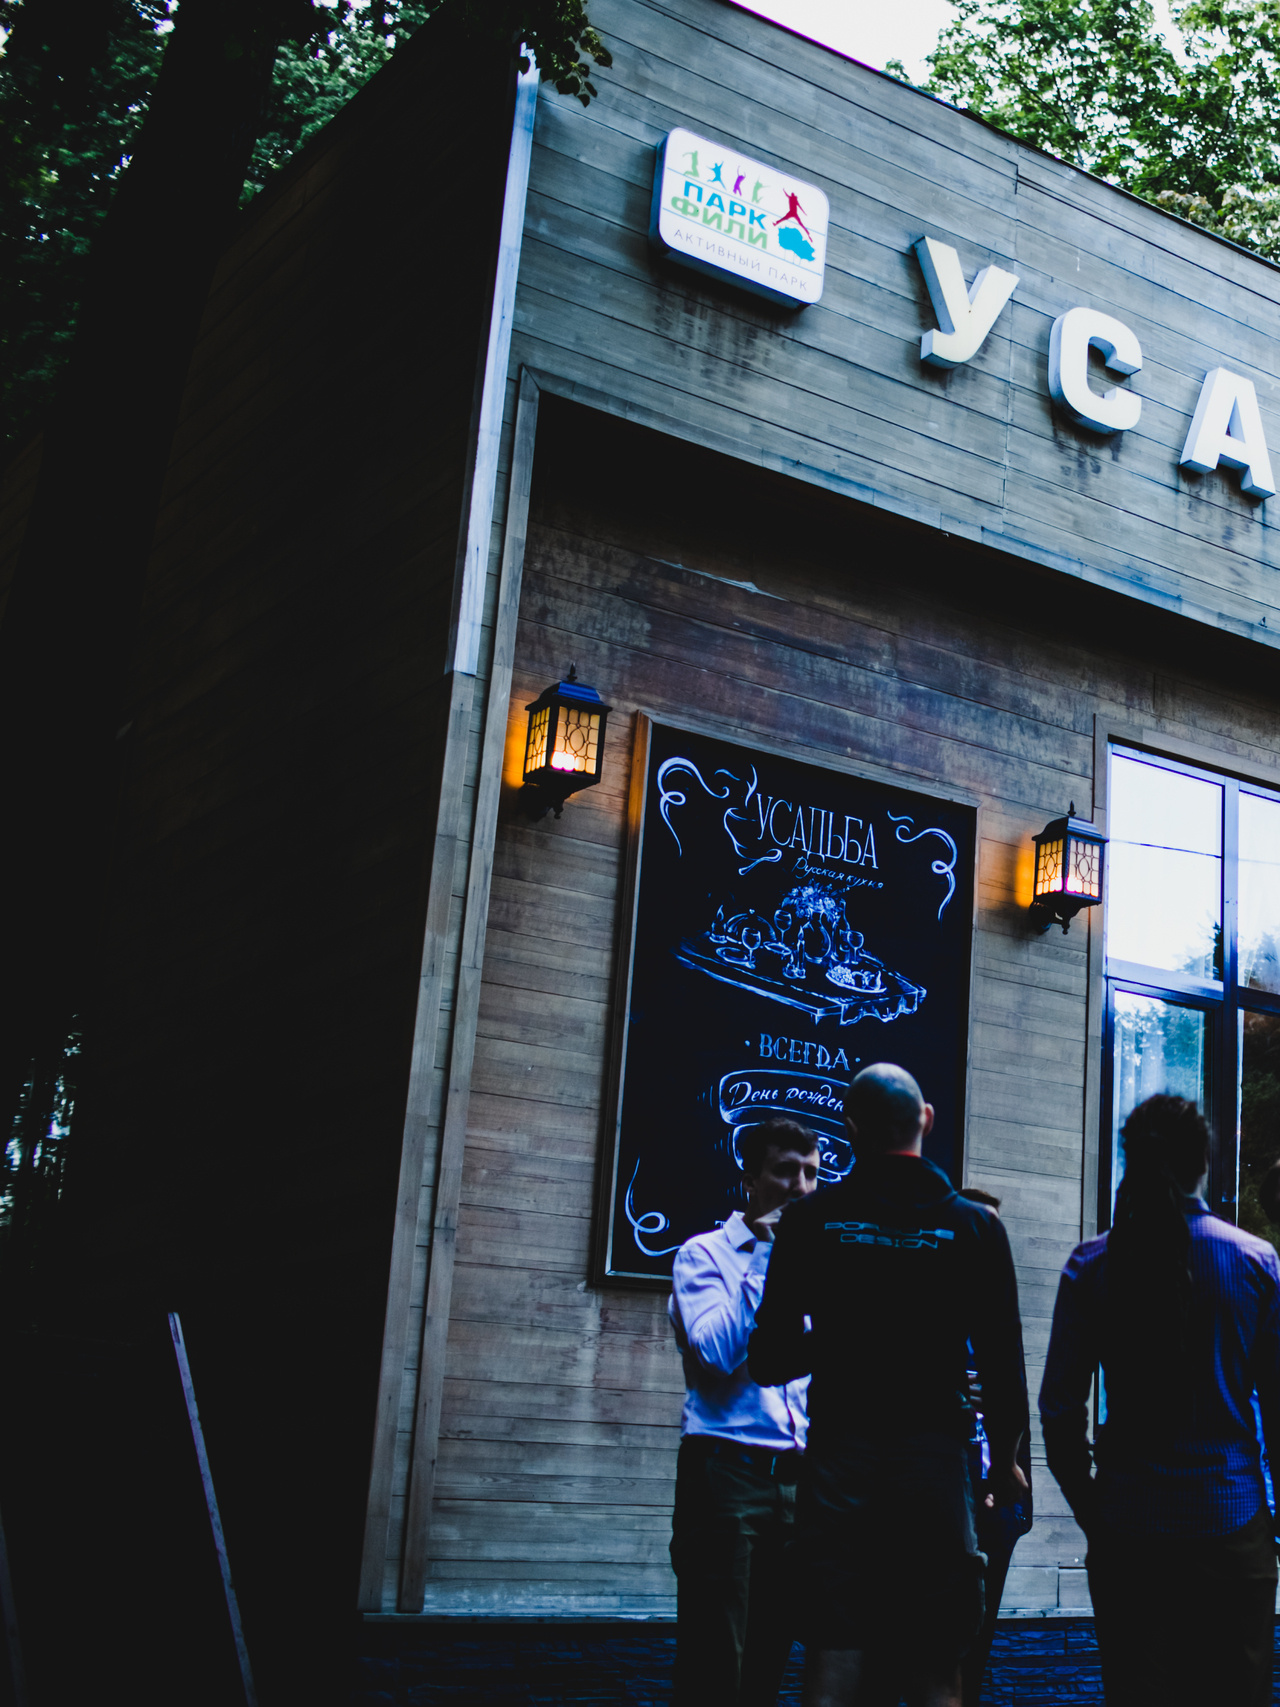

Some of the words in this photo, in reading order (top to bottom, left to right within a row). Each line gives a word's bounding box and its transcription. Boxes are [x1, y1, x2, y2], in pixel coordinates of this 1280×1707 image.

[671, 196, 768, 250] ФИЛИ
[684, 180, 768, 231] ПАРК
[673, 228, 761, 271] АКТИВНЫЙ
[768, 266, 807, 291] ПАРК
[755, 793, 879, 869] УСАДЬБА
[791, 856, 845, 880] Русская
[759, 1033, 851, 1071] ВСЕГДА
[728, 1081, 779, 1106] День
[785, 1084, 844, 1112] рожден
[840, 1233, 939, 1249] DESIGN
